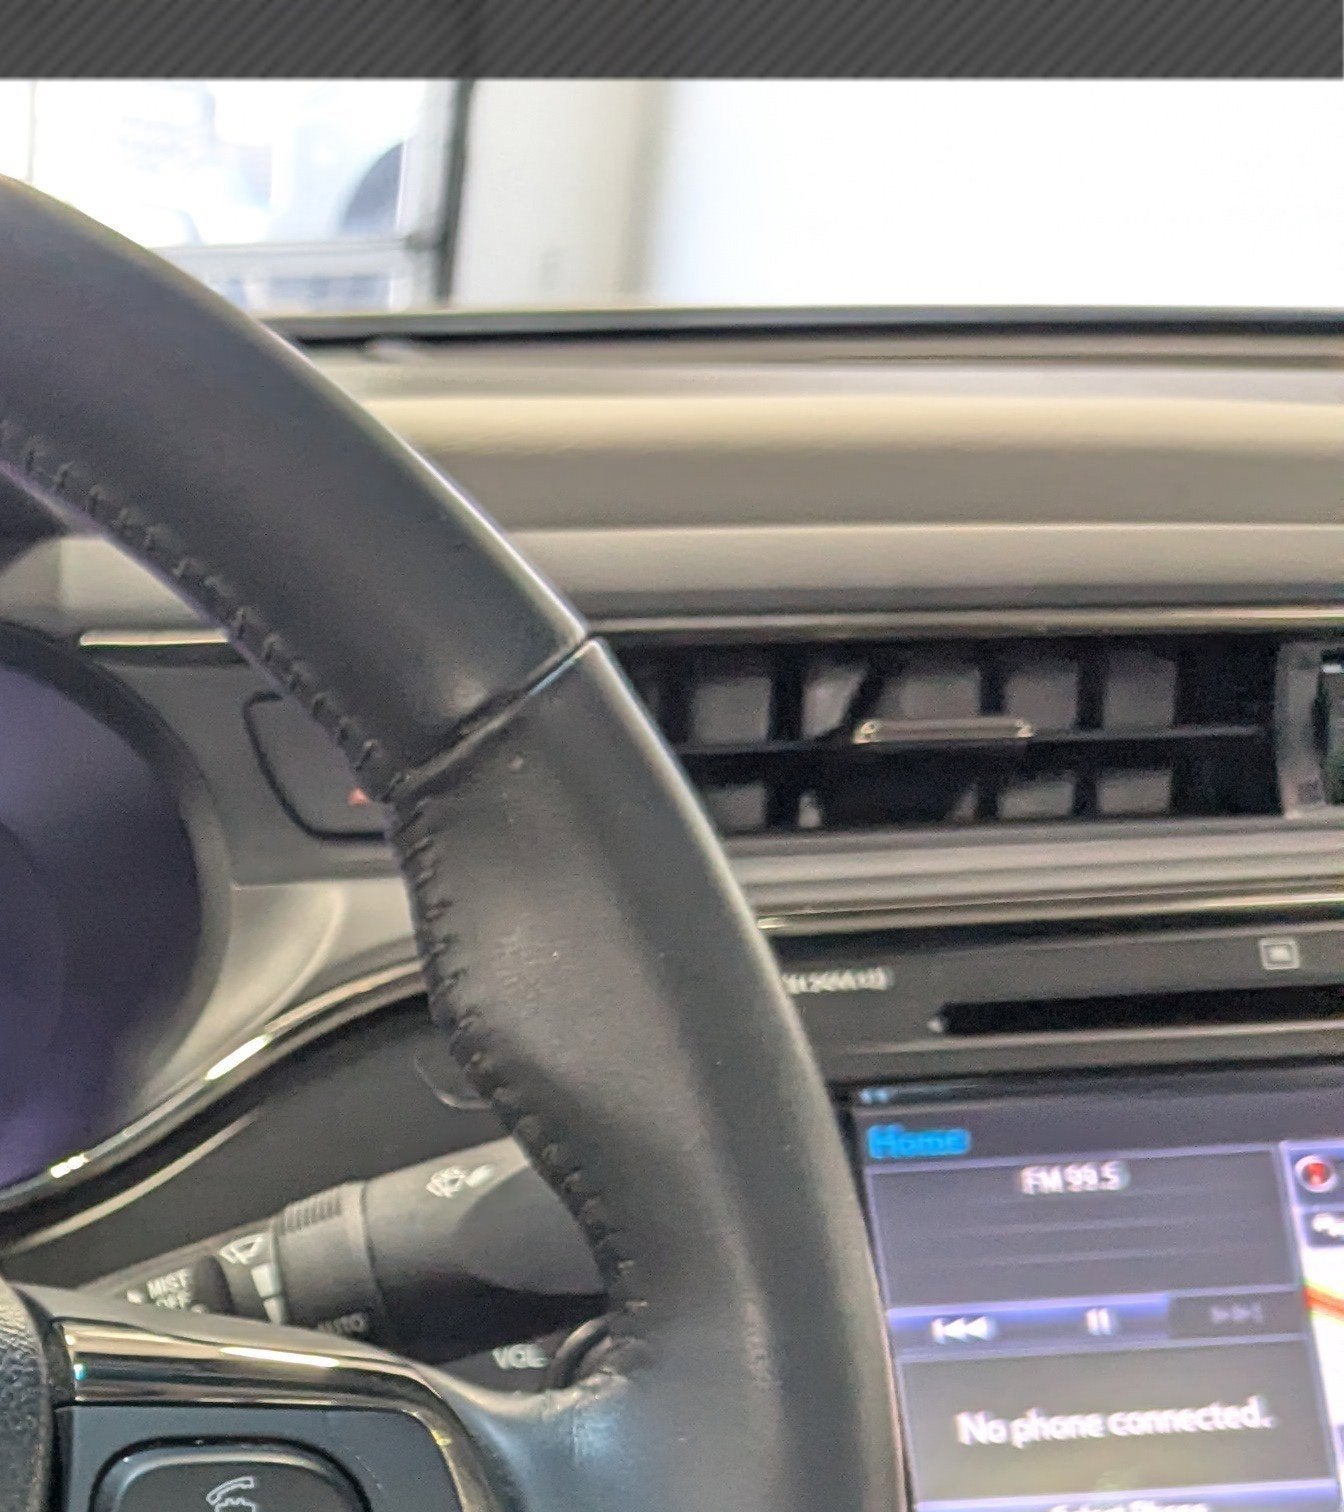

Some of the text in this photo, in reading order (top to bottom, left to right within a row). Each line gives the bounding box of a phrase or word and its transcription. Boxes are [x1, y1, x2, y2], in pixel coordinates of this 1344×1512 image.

[867, 1123, 971, 1160] Home
[1021, 1163, 1061, 1195] FM
[956, 1396, 1275, 1450] No phone connected.
